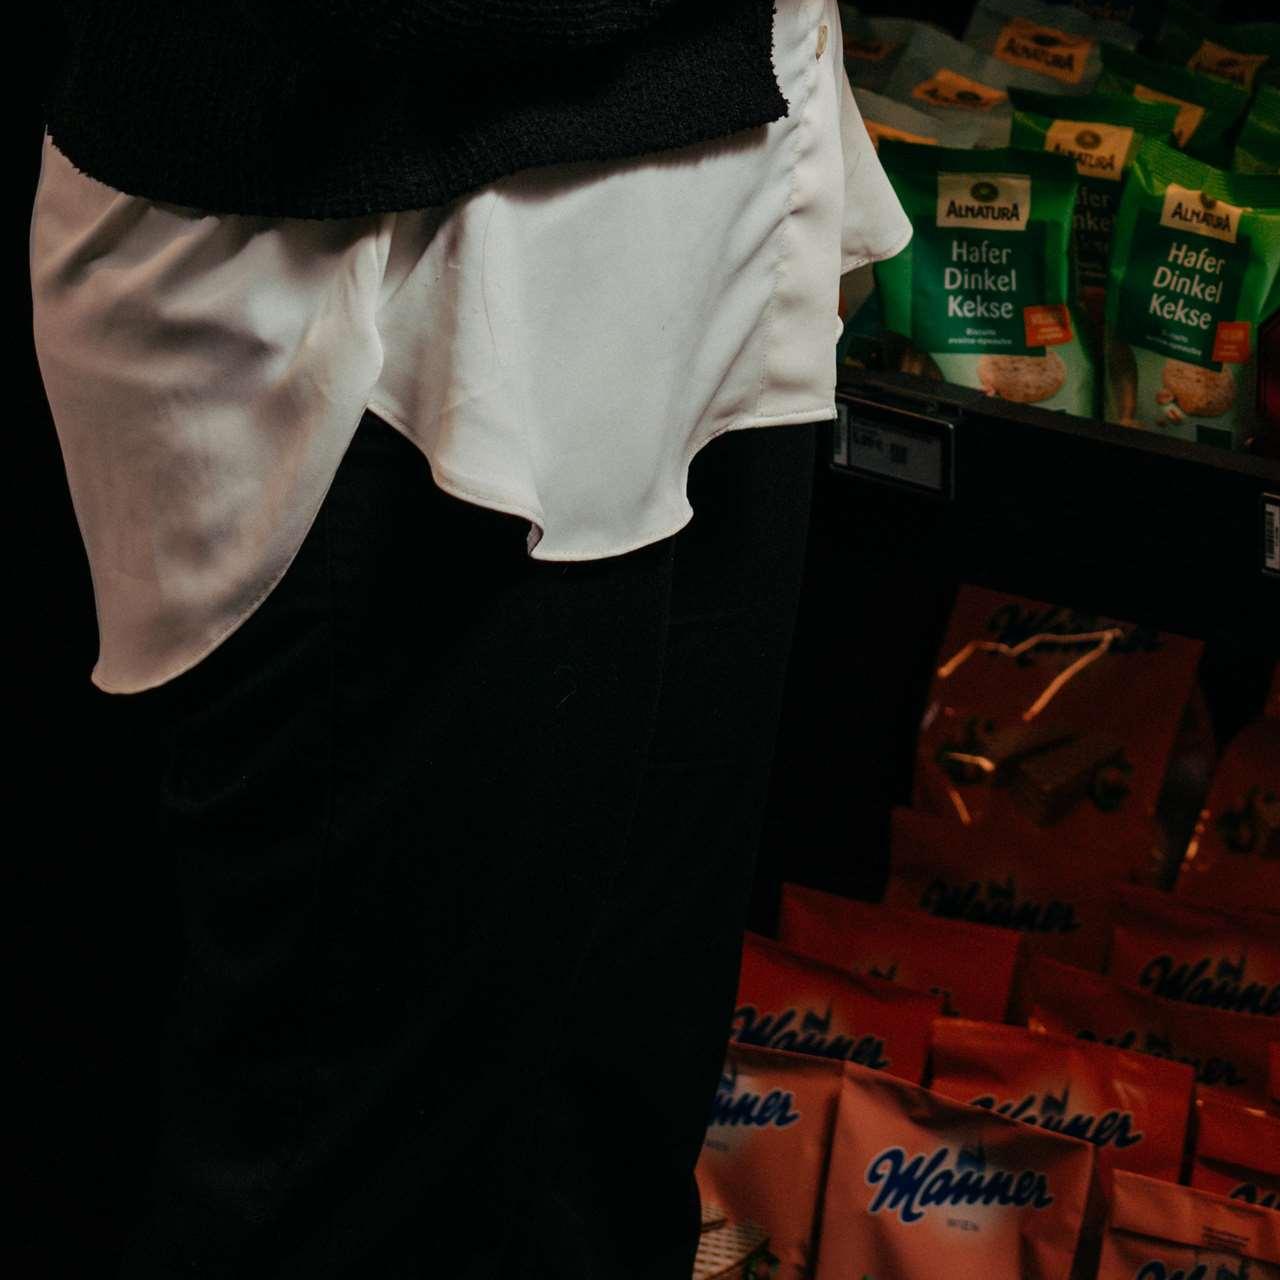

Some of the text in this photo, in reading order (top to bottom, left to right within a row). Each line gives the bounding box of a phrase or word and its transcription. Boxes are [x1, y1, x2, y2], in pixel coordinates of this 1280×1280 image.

[946, 201, 1019, 222] ALNATURA
[951, 241, 1012, 265] Hafer
[1167, 241, 1226, 275] Hafer
[943, 267, 1017, 292] Dinkel
[1152, 266, 1224, 305] Dinkel
[947, 294, 1014, 318] Kekse
[1149, 292, 1213, 330] Kekse
[868, 1147, 1054, 1223] Manner
